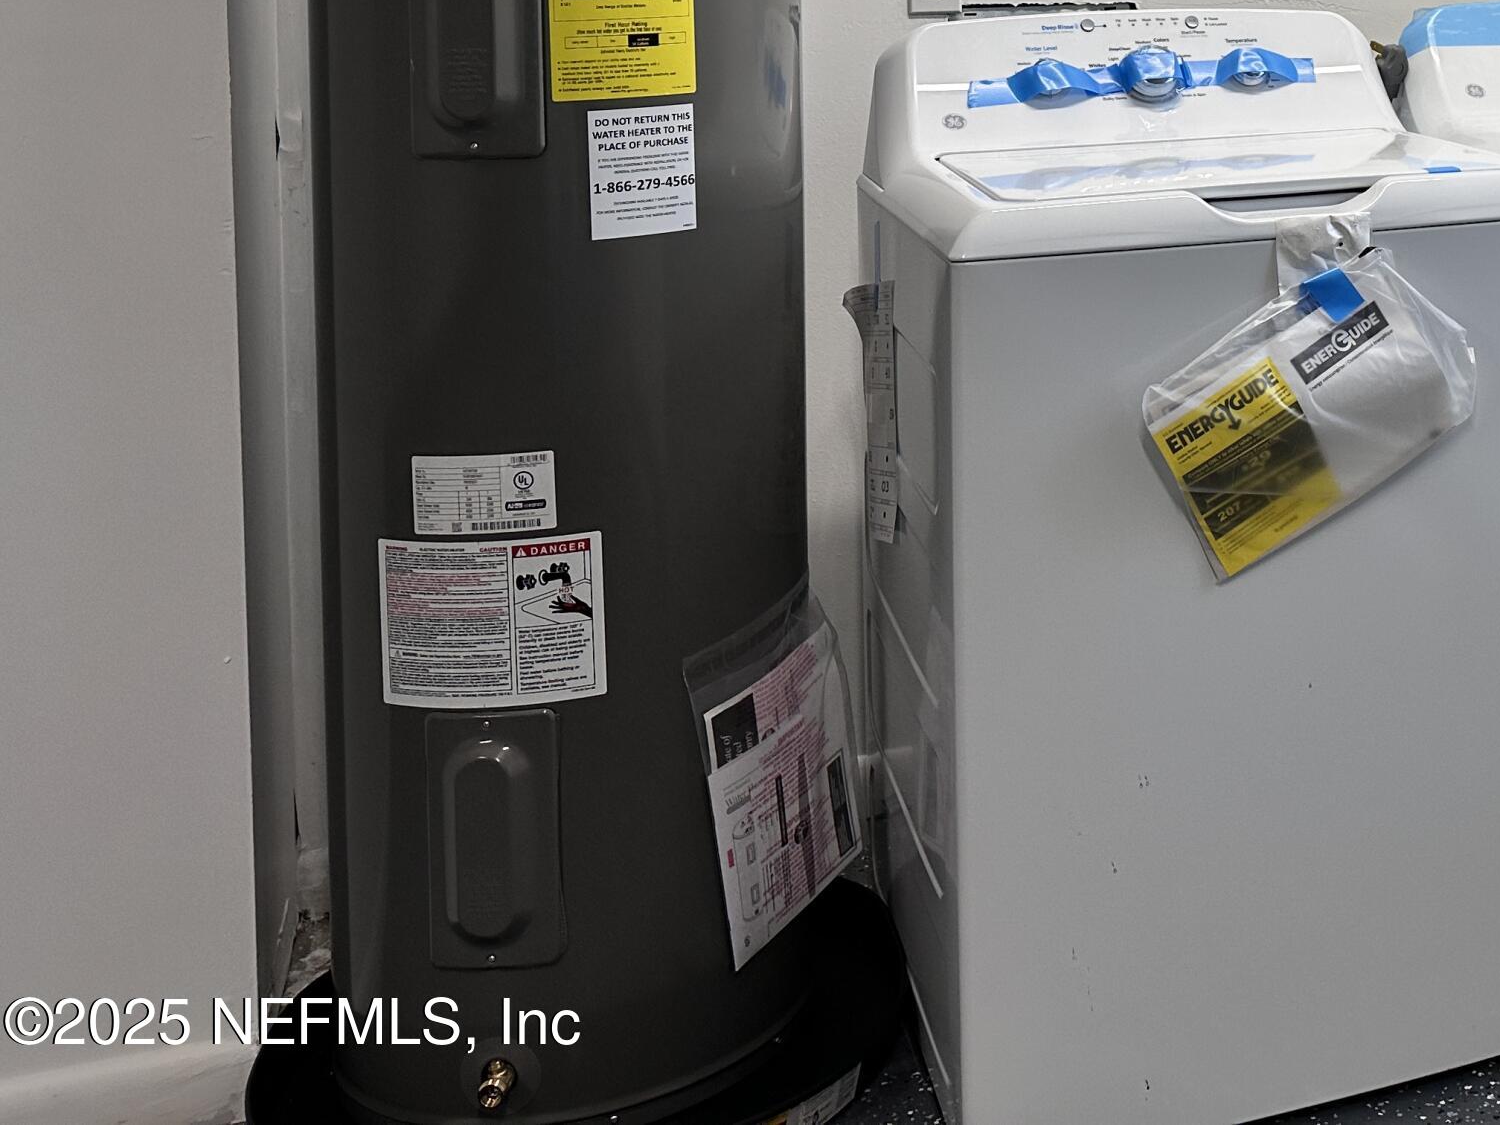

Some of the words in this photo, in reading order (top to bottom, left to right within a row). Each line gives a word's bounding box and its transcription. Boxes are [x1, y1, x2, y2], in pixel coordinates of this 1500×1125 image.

[594, 118, 609, 127] DO
[612, 117, 632, 126] NOT
[634, 114, 670, 124] RETURN
[671, 112, 690, 121] THIS
[592, 130, 626, 140] WATER
[627, 127, 661, 137] HEATER
[663, 125, 675, 134] TO
[677, 124, 693, 132] THE
[598, 142, 626, 151] PLACE
[629, 140, 641, 149] OF
[643, 136, 688, 148] PURCHASE
[593, 173, 695, 195] 1-866-279-4566
[1165, 368, 1280, 455] ENERGYGUIDE
[518, 475, 529, 486] UL
[1218, 502, 1240, 523] 207
[530, 541, 586, 556] DANGER
